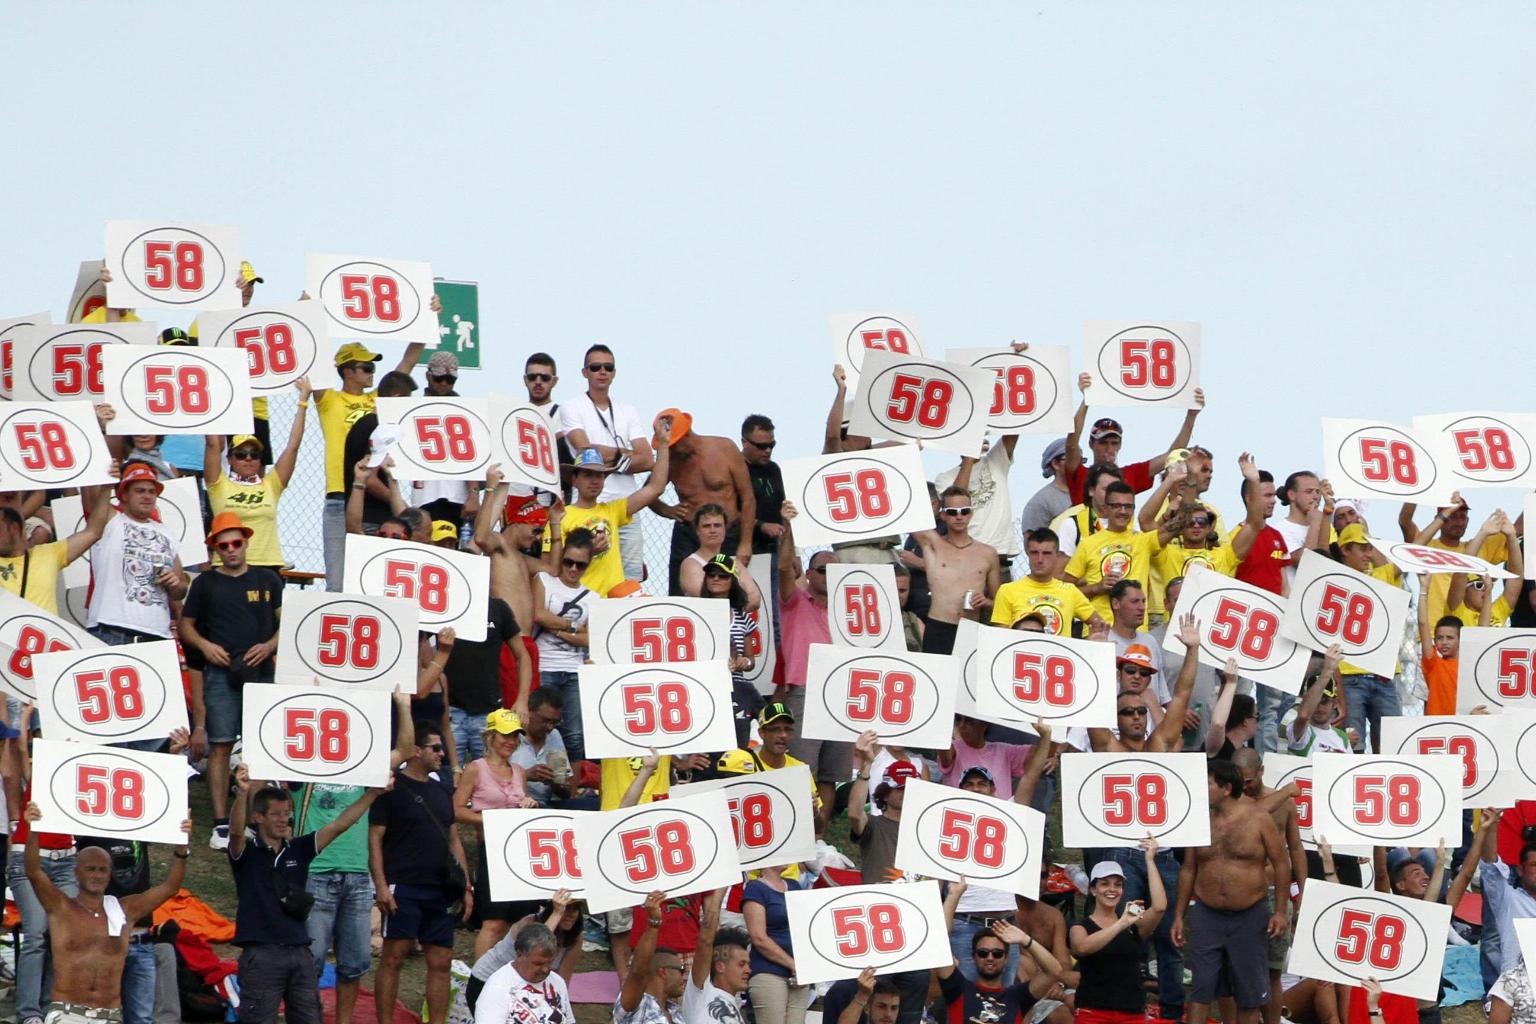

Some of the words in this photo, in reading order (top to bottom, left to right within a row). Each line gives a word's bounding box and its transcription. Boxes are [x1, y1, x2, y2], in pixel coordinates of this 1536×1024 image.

[143, 241, 205, 292] 58
[340, 274, 402, 323] 58
[233, 322, 298, 378] 58
[1119, 338, 1177, 389] 58
[143, 365, 211, 415] 58
[884, 373, 955, 430] 58
[12, 421, 76, 472] 58
[413, 414, 477, 463] 58
[515, 418, 556, 475] 58
[1358, 437, 1419, 487] 58
[1452, 427, 1517, 472] 58
[822, 468, 892, 523] 58
[1407, 546, 1472, 568] 58
[384, 559, 450, 615] 58
[842, 584, 883, 637] 58
[316, 613, 382, 670] 58
[630, 616, 697, 665] 58
[1207, 597, 1279, 662] 58
[1314, 583, 1375, 647] 58
[73, 665, 146, 725] 58
[845, 669, 916, 725] 58
[1012, 651, 1075, 707] 58
[284, 708, 351, 764] 58
[621, 682, 692, 736] 58
[76, 765, 145, 821] 58
[1101, 773, 1168, 827] 58
[1353, 774, 1421, 827] 58
[618, 819, 695, 883] 58
[937, 808, 1007, 869] 58
[832, 903, 905, 958] 58
[1333, 908, 1407, 971] 58
